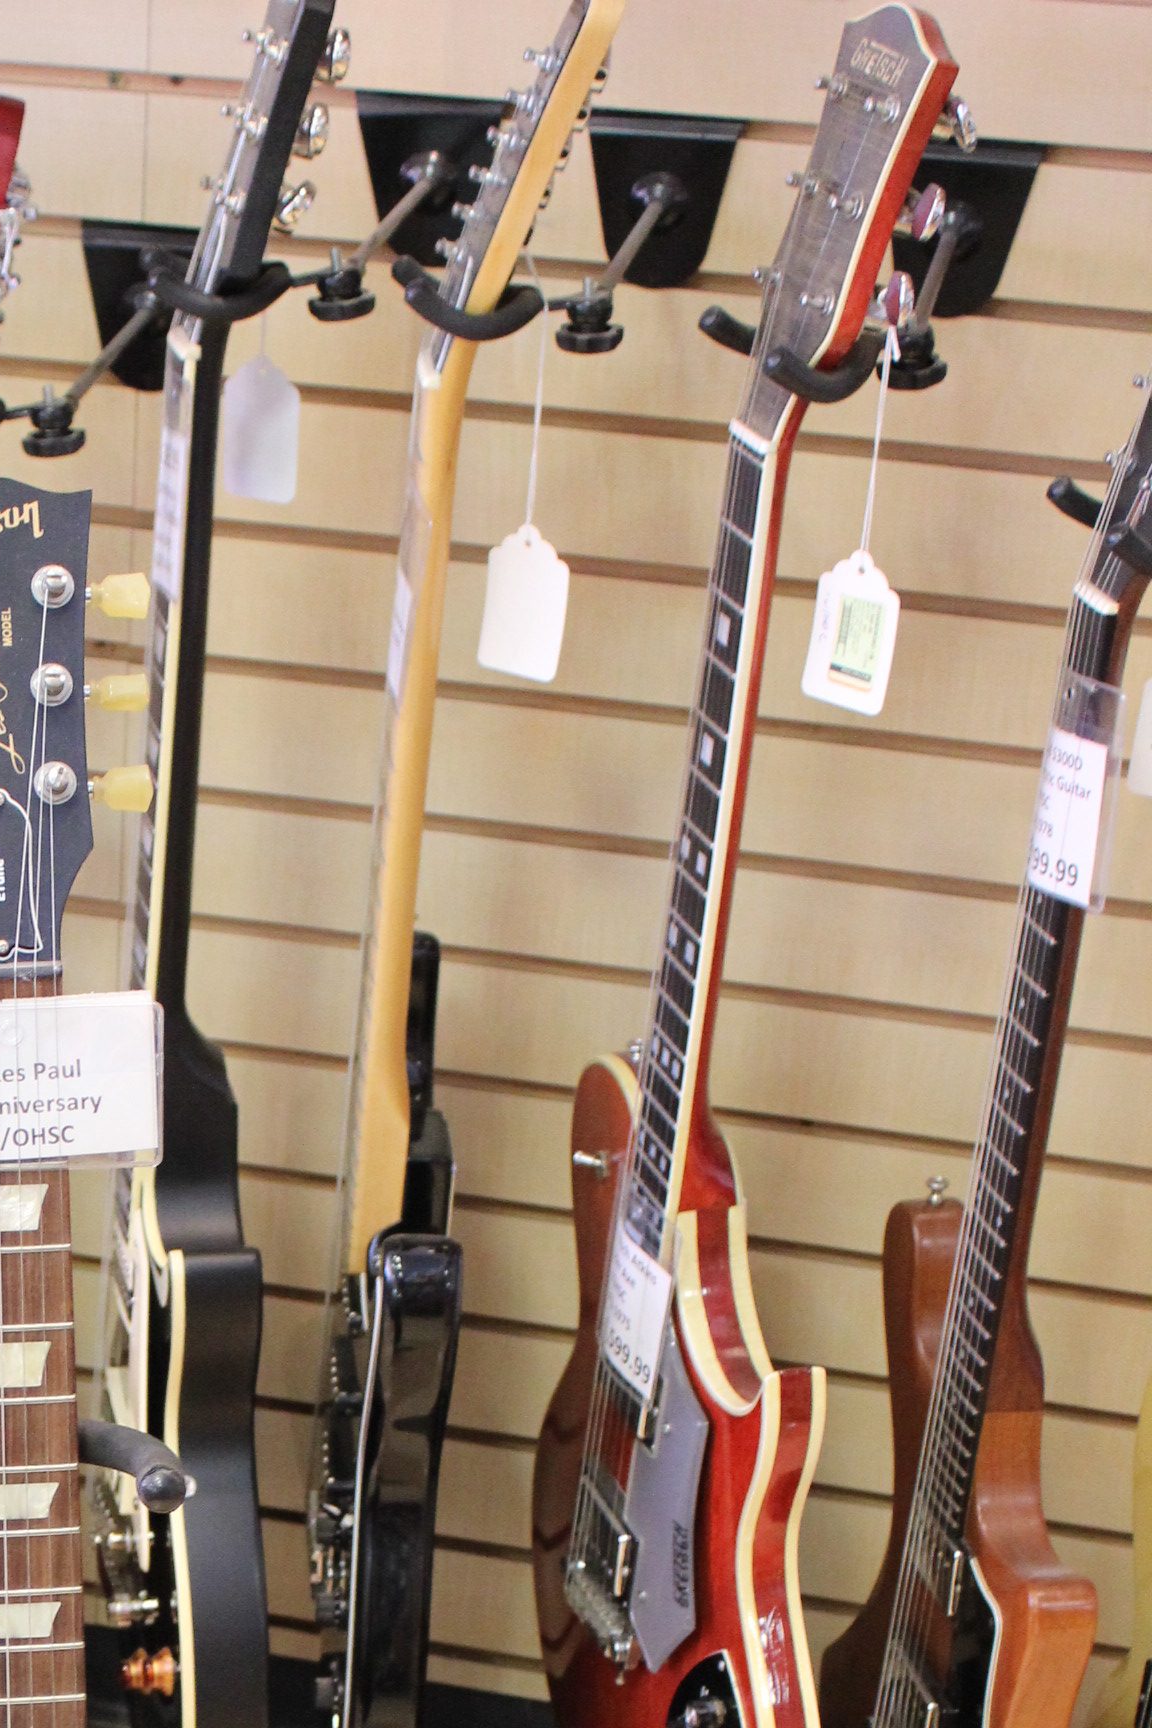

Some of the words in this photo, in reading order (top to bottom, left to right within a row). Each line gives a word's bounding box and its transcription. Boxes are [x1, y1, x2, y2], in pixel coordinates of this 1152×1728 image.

[2, 607, 12, 647] MODEL
[1056, 777, 1092, 800] Guitar
[33, 1059, 82, 1081] Paul
